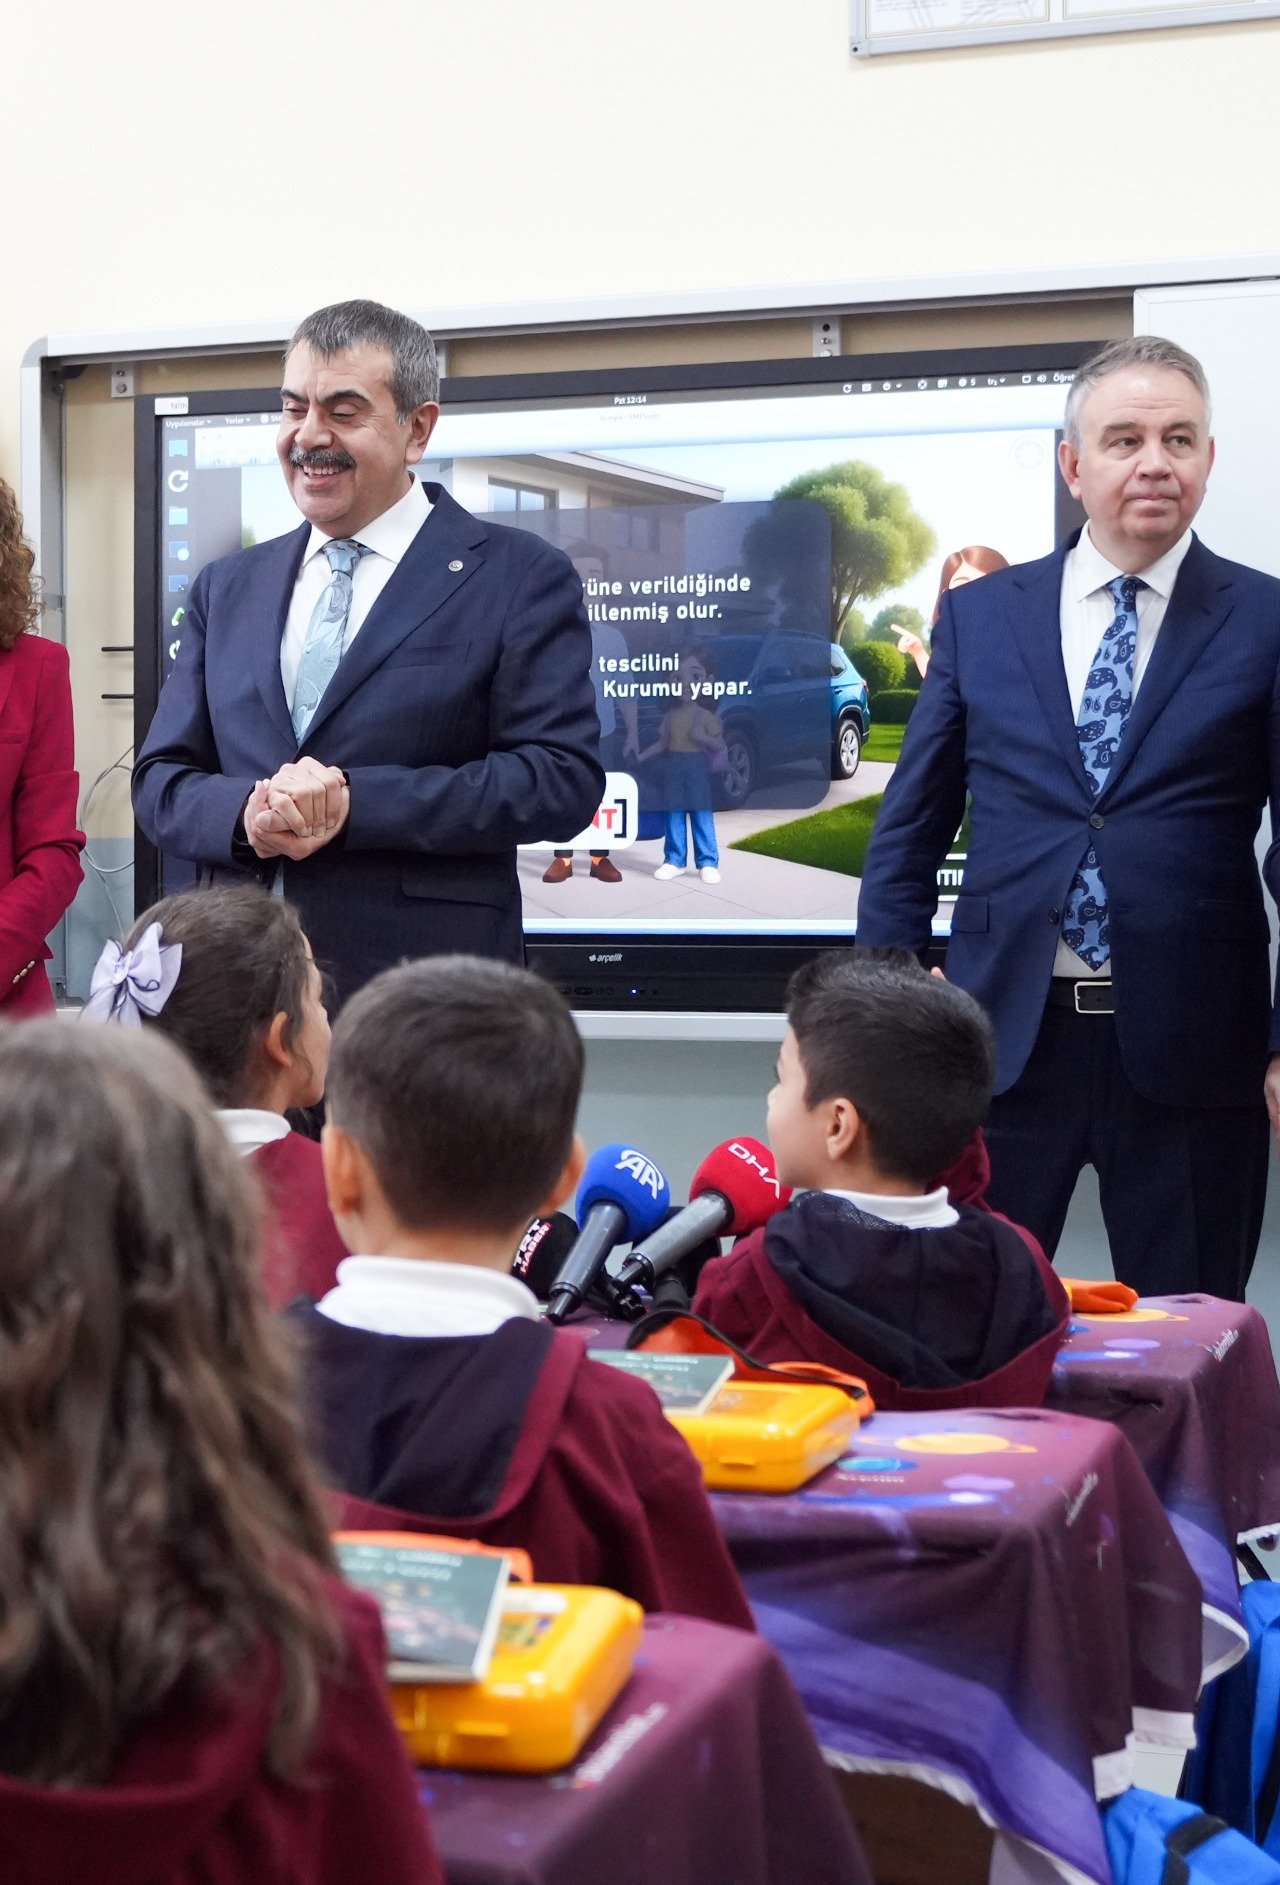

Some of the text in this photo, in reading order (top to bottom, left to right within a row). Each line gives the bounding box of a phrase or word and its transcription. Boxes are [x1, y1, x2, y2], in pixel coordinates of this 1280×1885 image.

[626, 396, 647, 404] 12:14
[165, 419, 205, 428] Uygulamalar
[583, 573, 751, 597] üne verildiğinde
[588, 601, 723, 623] illenmiş olur.
[599, 653, 680, 672] tescilini
[603, 680, 752, 700] Kurumu yapar.
[597, 953, 623, 963] arçelik
[615, 1150, 664, 1200] AA
[727, 1142, 781, 1199] DHA
[513, 1218, 540, 1267] TRT
[520, 1223, 551, 1274] HABER
